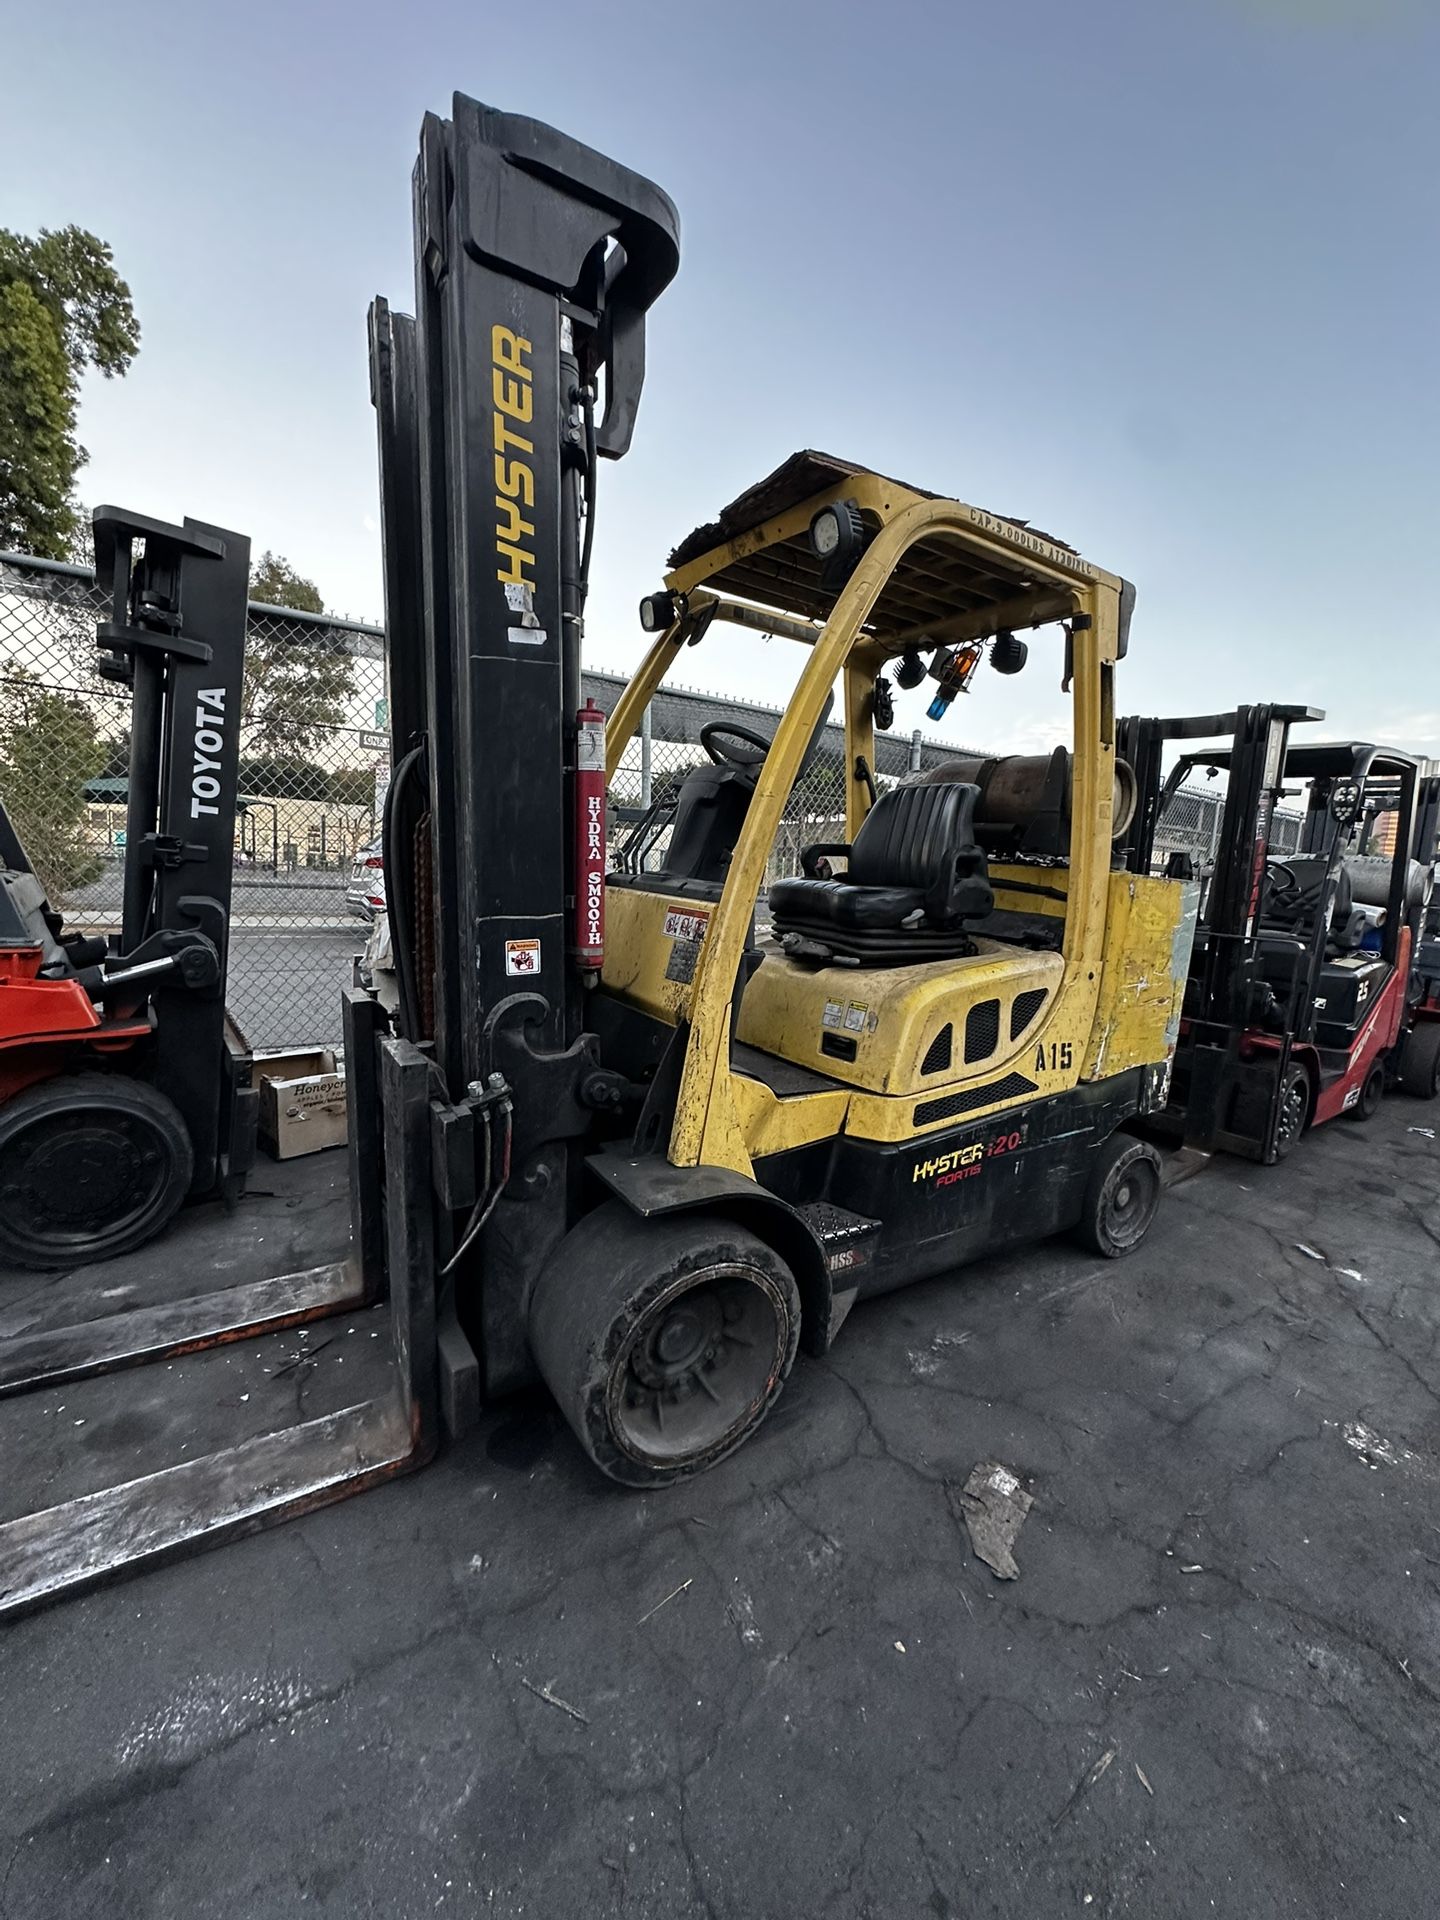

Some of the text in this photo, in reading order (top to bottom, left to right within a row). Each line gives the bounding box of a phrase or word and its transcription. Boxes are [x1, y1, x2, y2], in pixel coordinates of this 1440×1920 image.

[491, 324, 536, 593] HYSTER
[190, 688, 226, 819] TOYOTA
[588, 796, 602, 944] HYDRA SMOOTH
[1035, 1042, 1072, 1071] A15
[913, 1143, 984, 1182] HYSTER
[936, 1164, 982, 1188] FORTIS
